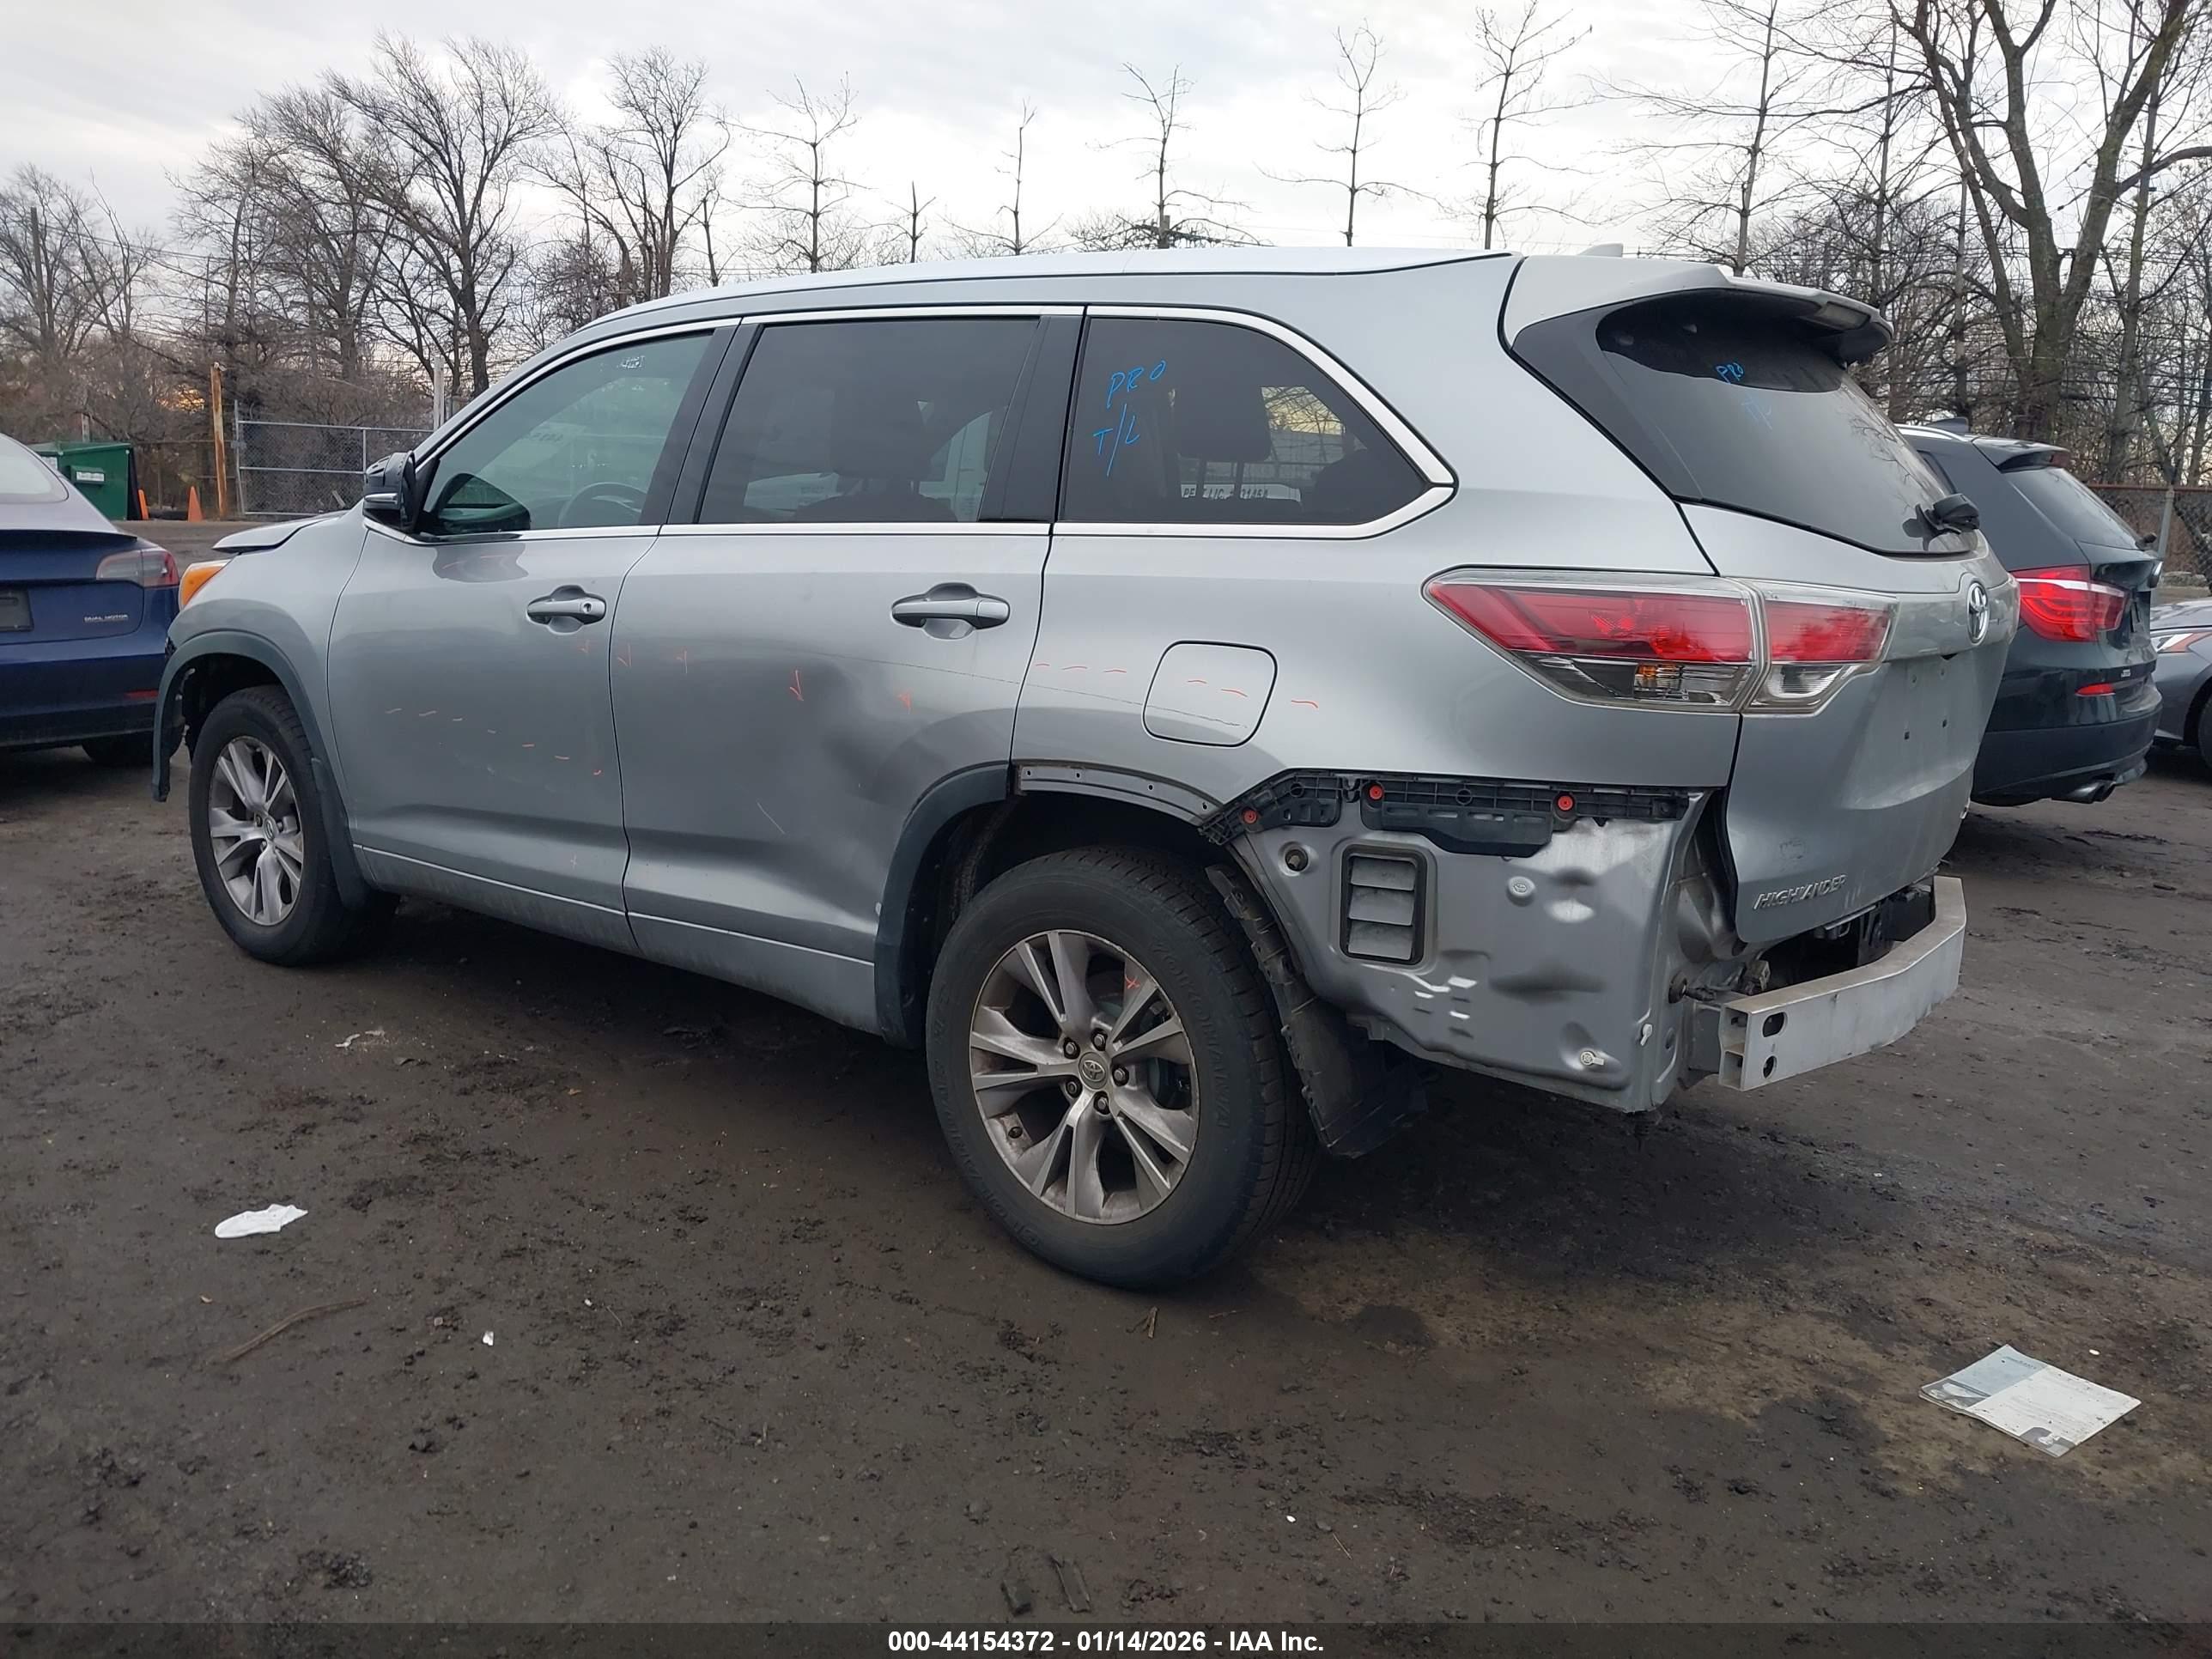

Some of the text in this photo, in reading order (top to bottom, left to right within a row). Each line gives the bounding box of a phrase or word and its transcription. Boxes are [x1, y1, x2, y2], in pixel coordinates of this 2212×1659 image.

[1106, 360, 1167, 409] PRO
[1092, 403, 1140, 477] T/L
[1753, 874, 1847, 910] HIGHLANDER
